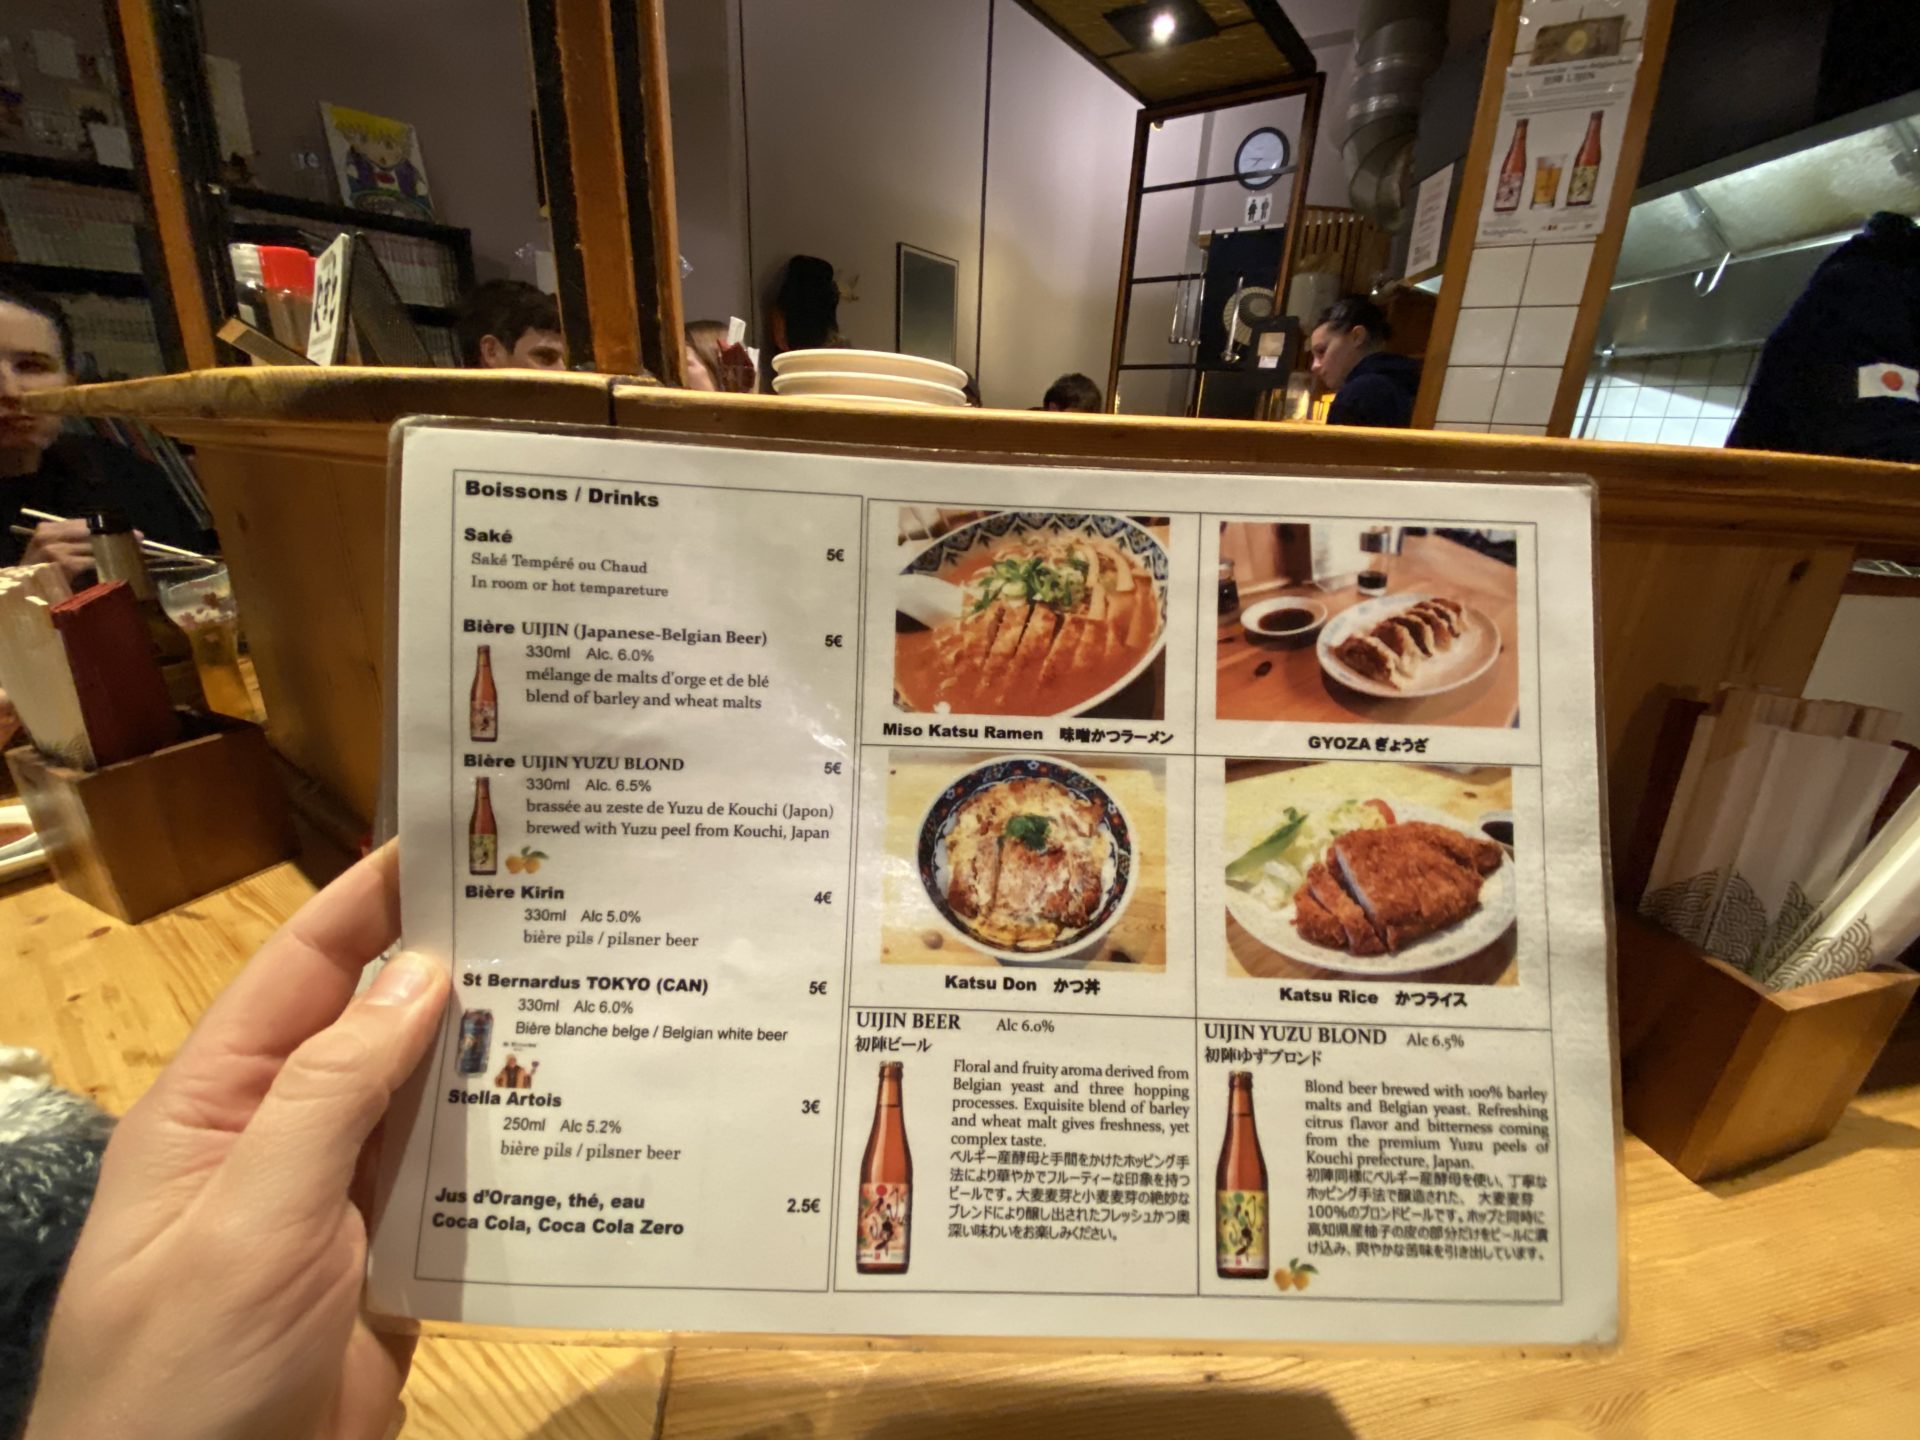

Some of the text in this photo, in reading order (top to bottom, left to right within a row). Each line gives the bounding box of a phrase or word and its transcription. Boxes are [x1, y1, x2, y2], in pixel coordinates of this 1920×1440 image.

[466, 480, 659, 507] Boissons / Drinks
[464, 528, 512, 543] Saké
[471, 552, 647, 573] Saké Tempéré ou Chaud
[827, 549, 844, 562] 5€
[472, 575, 668, 597] In room or hot tempareture
[464, 619, 515, 634] Bière
[522, 622, 569, 638] UIJIN
[726, 631, 767, 646] Beer)
[825, 635, 842, 647] 5€
[526, 645, 654, 662] 330ml Alc. 6.0%
[526, 667, 591, 685] mélange
[594, 669, 612, 682] de
[617, 670, 657, 684] malts
[709, 676, 723, 686] et
[727, 674, 744, 687] de
[748, 674, 769, 688] blé
[526, 689, 761, 709] blend of barley and wheat malts
[883, 723, 1043, 740] Miso Katsu Ramen
[1060, 727, 1174, 744] 味噌かつラーメン
[1308, 736, 1371, 750] GYOZA
[1375, 737, 1429, 753] ぎょうざ
[464, 754, 684, 771] Bière UIJIN YUZU BLOND
[824, 762, 841, 775] 5€
[526, 778, 651, 792] 330ml Alc. 6.5%
[526, 798, 833, 820] brassée au zeste de Yuzu de Kouchi (Japon)
[526, 820, 829, 842] brewed with Yuzu peel from Kouchi, Japan
[465, 885, 564, 899] Bière Kirin
[814, 891, 832, 904] 4€
[525, 908, 641, 923] 330ml Alc 5.0%
[524, 929, 699, 948] bière pils / pilsner beer
[463, 973, 708, 995] St Bernardus TOKYO (CAN)
[809, 981, 827, 995] 5€
[945, 975, 1036, 991] Katsu Don
[1054, 978, 1100, 995] かつ丼
[1280, 988, 1378, 1004] Katsu Rice
[1395, 991, 1467, 1007] かつライス
[518, 998, 633, 1014] 330ml Alc 6.0%
[857, 1012, 960, 1031] UIJIN BEER
[996, 1018, 1018, 1031] Alc
[516, 1021, 788, 1042] Bière blanche belge / Belgian white beer
[1205, 1023, 1386, 1044] UIJIN YUZU BLOND
[1407, 1033, 1428, 1047] Alc
[855, 1035, 932, 1052] 初陣ビール
[1205, 1046, 1321, 1066] 初陣ゆずブロンド
[954, 1059, 1189, 1079] Floral and fruity aroma derived from
[953, 1077, 1189, 1101] Belgian yeast and three hopping
[1305, 1080, 1343, 1094] Blond
[1348, 1081, 1377, 1094] beer
[1381, 1082, 1429, 1096] brewed
[1434, 1084, 1464, 1098] with
[1507, 1086, 1547, 1104] barley
[448, 1089, 561, 1107] Stella Artois
[802, 1100, 820, 1114] 3€
[952, 1097, 1189, 1119] processes. Exquisite blend of barley
[503, 1117, 621, 1134] 250ml Alc 5.2%
[501, 1140, 681, 1161] bière pils / pilsner beer
[435, 1188, 467, 1203] Jus
[569, 1193, 603, 1211] thé,
[611, 1197, 645, 1209] eau
[787, 1198, 820, 1213] 2.5€
[432, 1212, 684, 1235] Coca Cola, Coca Cola Zero
